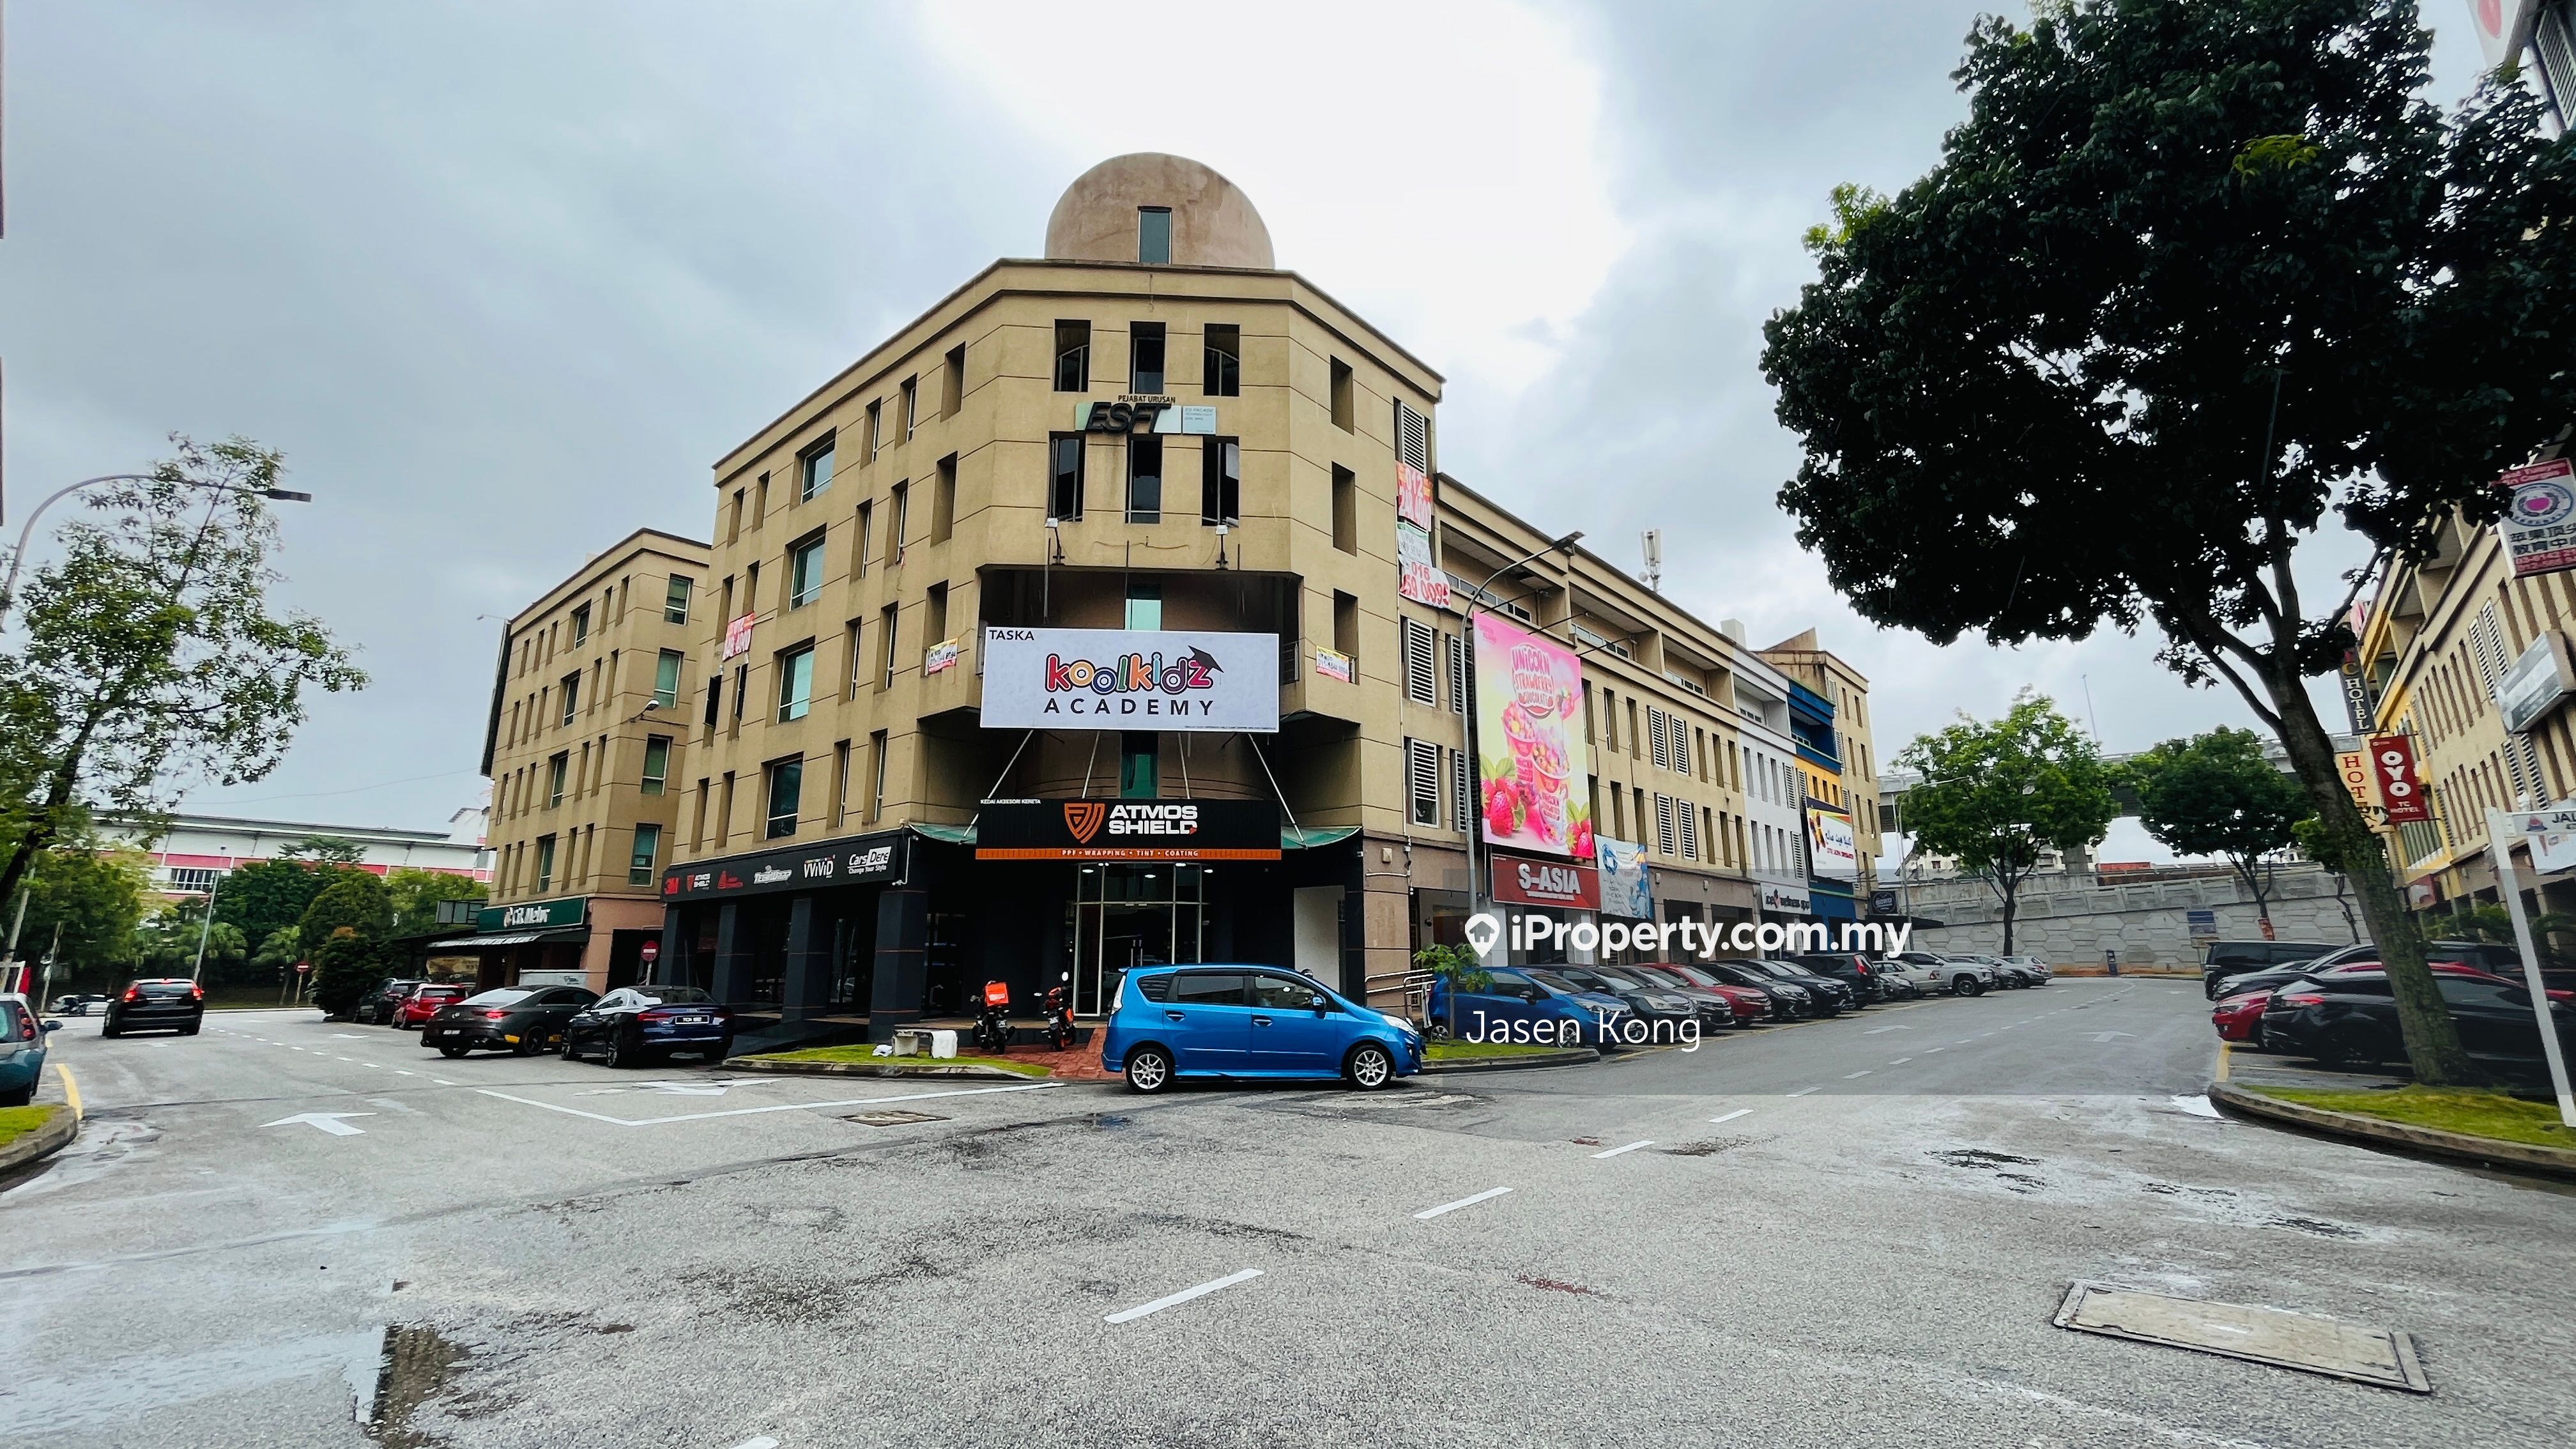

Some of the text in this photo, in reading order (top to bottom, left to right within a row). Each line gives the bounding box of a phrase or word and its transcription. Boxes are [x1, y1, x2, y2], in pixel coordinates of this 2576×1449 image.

[989, 630, 1034, 641] TASKA
[1045, 652, 1213, 694] koolkidz
[1043, 698, 1213, 716] ACADEMY
[2345, 677, 2370, 730] HOTEL
[2381, 751, 2411, 797] OYO
[1109, 805, 1198, 820] ATMOS
[1108, 820, 1198, 834] SHIELD
[849, 854, 868, 866] Cars
[1518, 863, 1581, 894] S-ASIA
